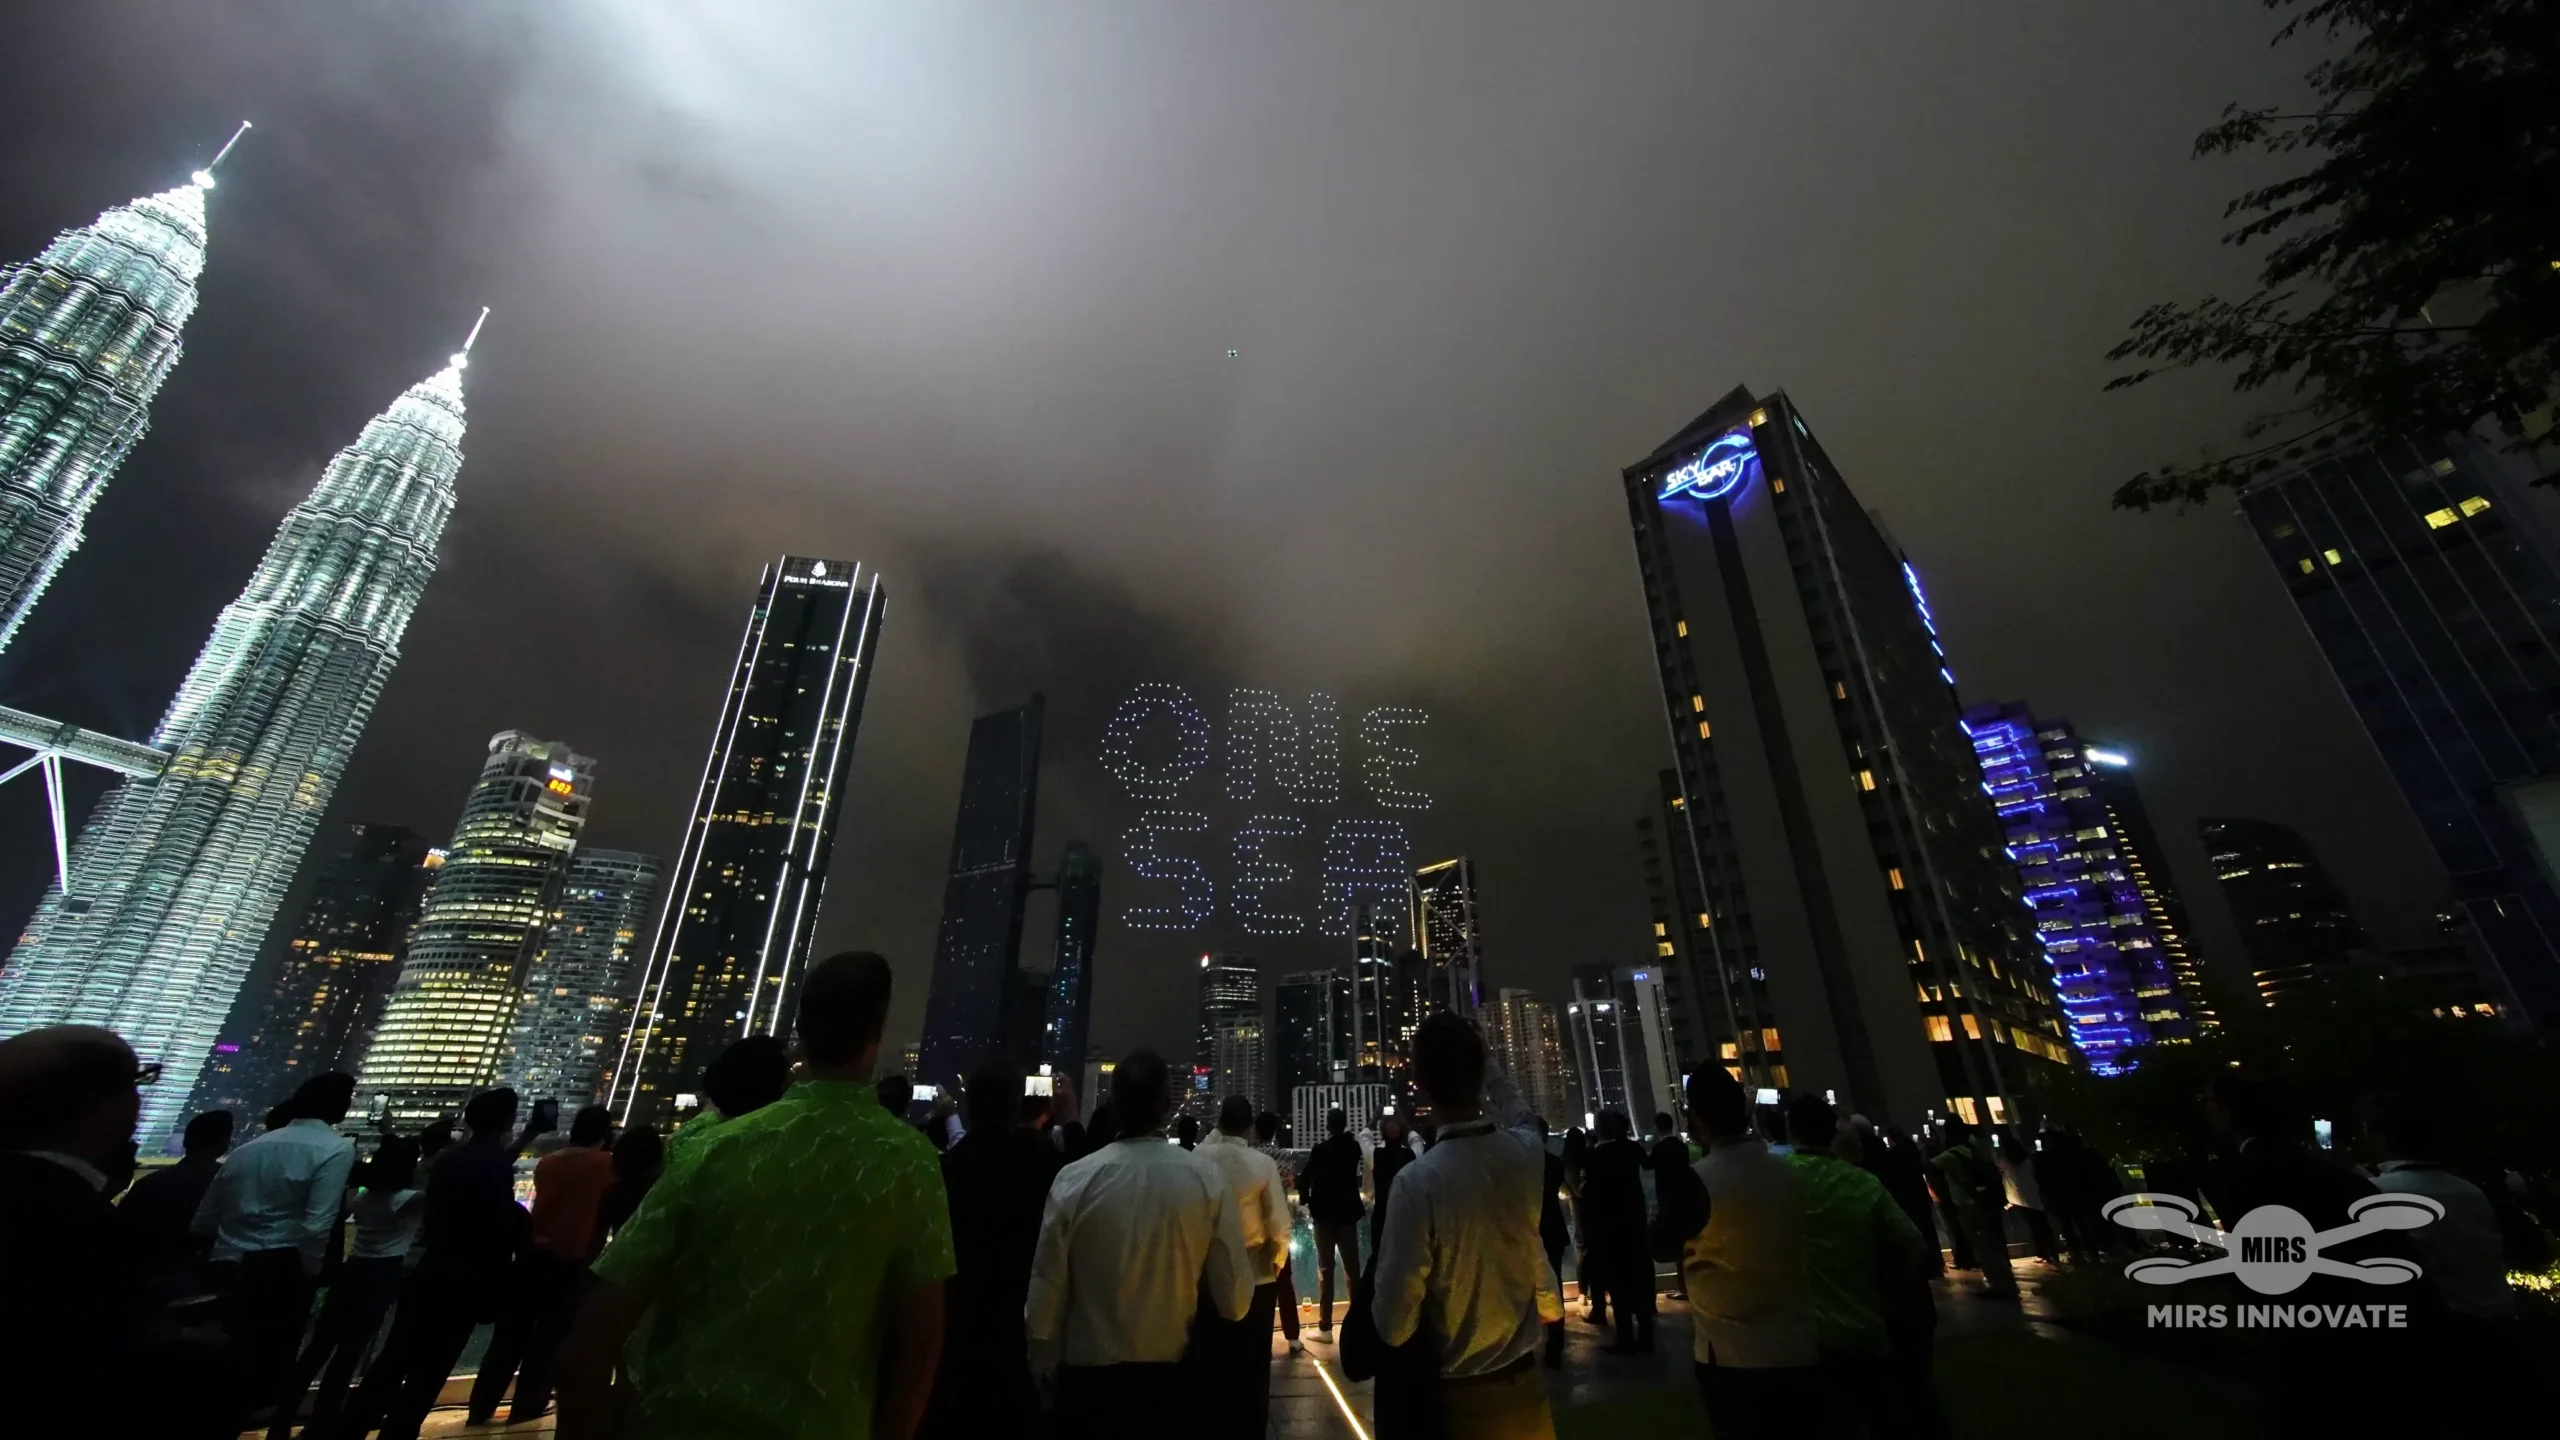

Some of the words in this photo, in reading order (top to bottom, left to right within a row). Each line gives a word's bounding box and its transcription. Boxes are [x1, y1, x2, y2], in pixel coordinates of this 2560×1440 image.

[1667, 460, 1701, 490] SKY
[1697, 460, 1735, 487] BAR
[1099, 682, 1433, 810] ONE
[1122, 809, 1411, 937] SEA
